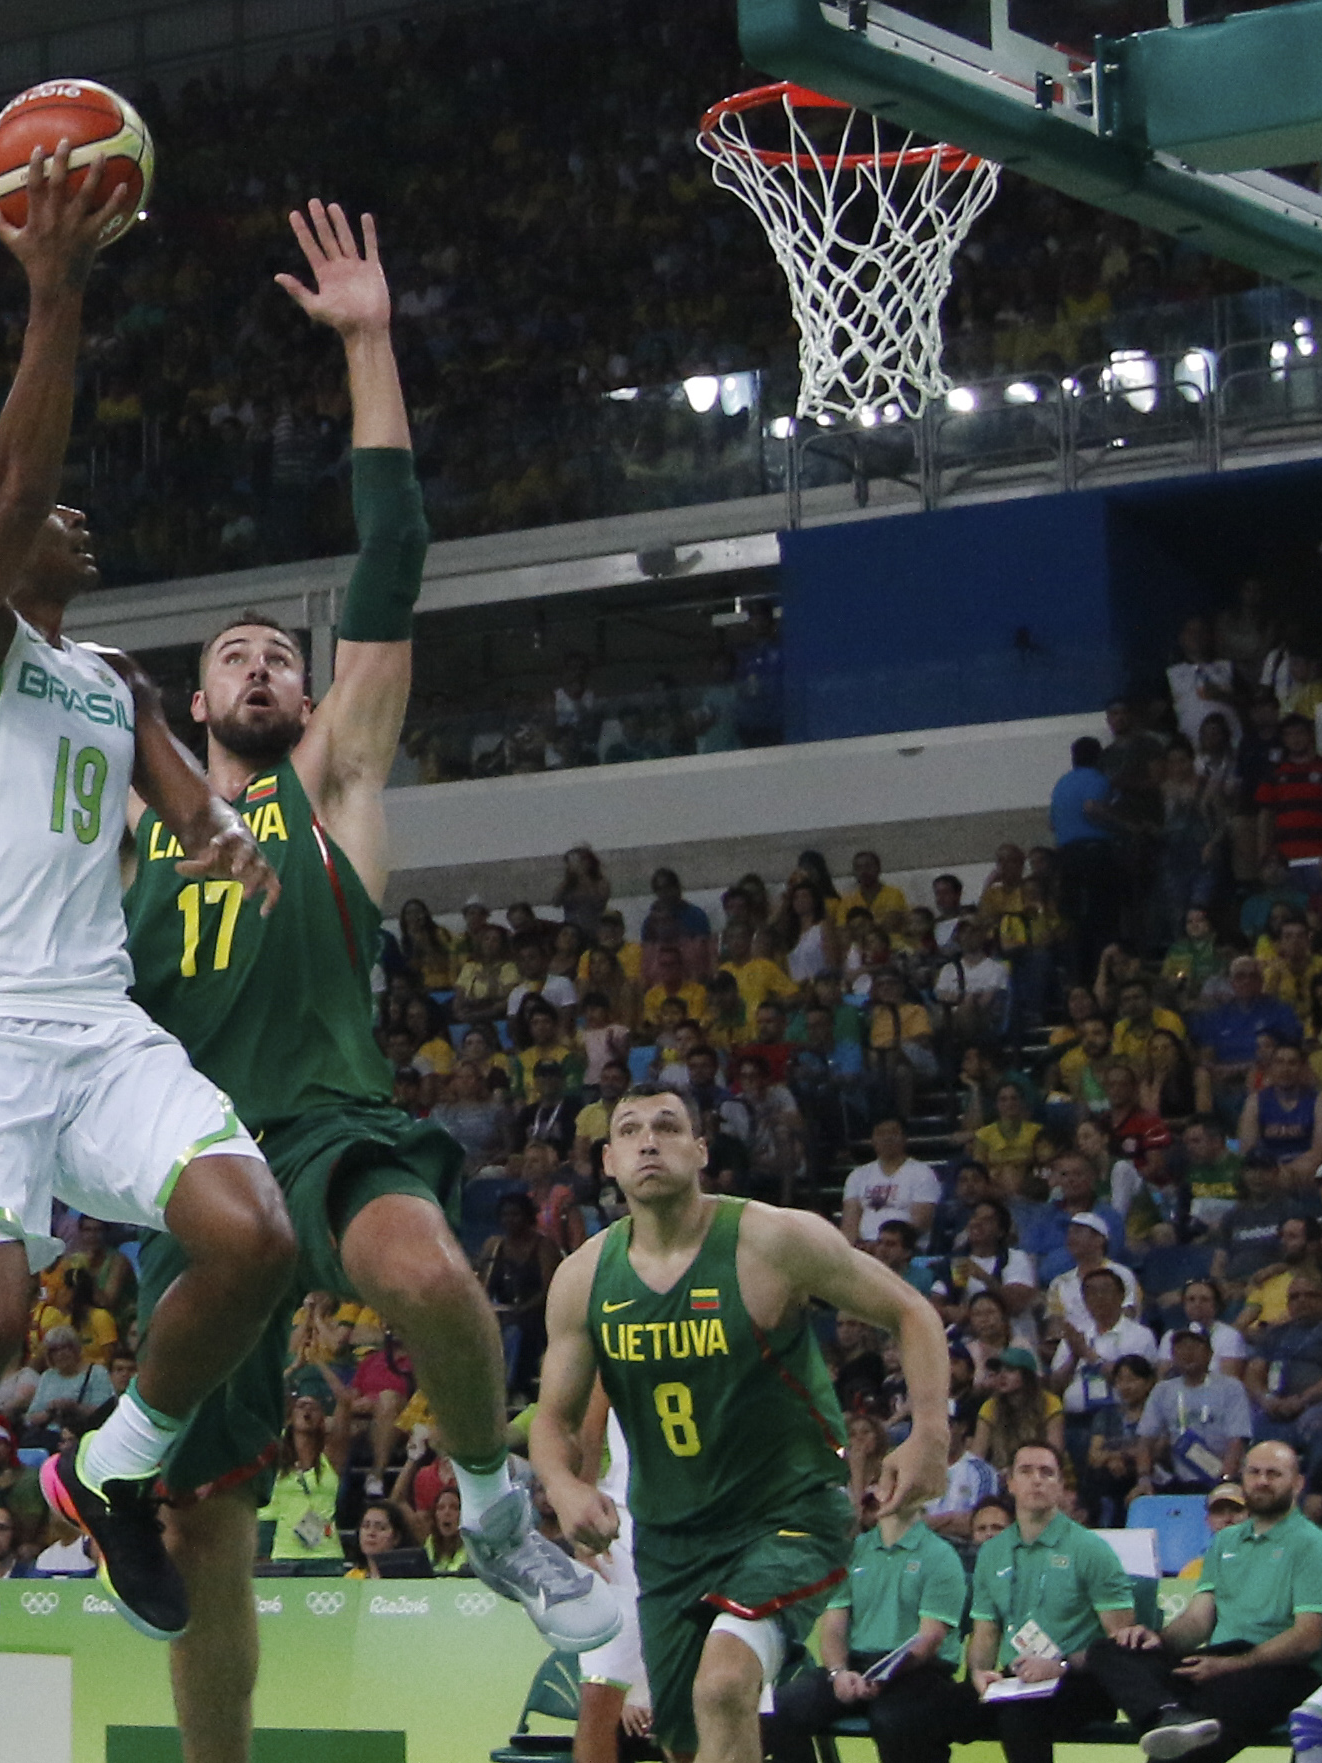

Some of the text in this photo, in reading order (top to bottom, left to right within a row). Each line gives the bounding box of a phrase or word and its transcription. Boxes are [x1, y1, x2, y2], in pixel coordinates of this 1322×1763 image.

[18, 661, 134, 732] BRASIL
[50, 736, 107, 845] 19
[178, 879, 245, 977] 17
[601, 1318, 729, 1361] LIETUVA
[653, 1381, 701, 1457] 8
